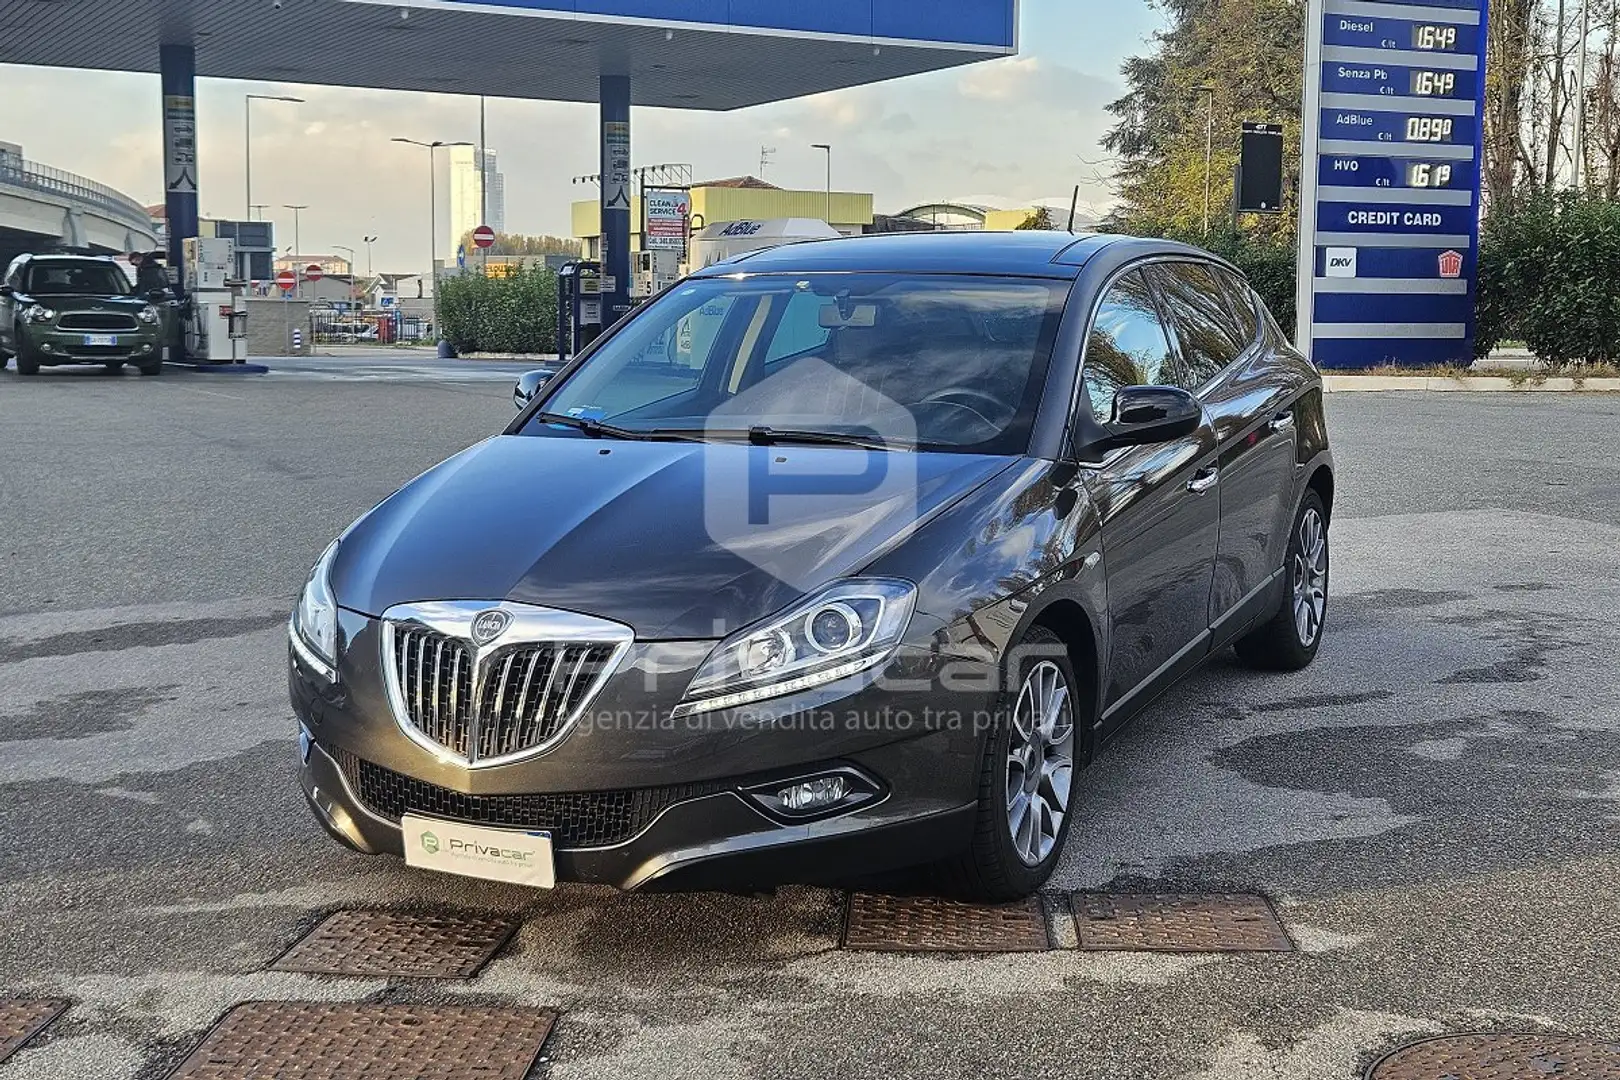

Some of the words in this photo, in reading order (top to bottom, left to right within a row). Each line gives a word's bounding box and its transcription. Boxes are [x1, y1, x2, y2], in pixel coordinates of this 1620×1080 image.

[1339, 20, 1374, 33] Diesel
[1338, 67, 1371, 79] Senza
[1374, 69, 1388, 80] Pb
[1336, 114, 1373, 126] AdBlue
[1334, 160, 1358, 171] HVO
[1347, 211, 1400, 225] CREDIT
[1403, 212, 1442, 226] CARD
[718, 221, 761, 236] AdBlue
[1329, 258, 1352, 267] DKV
[450, 838, 536, 861] Privacar
